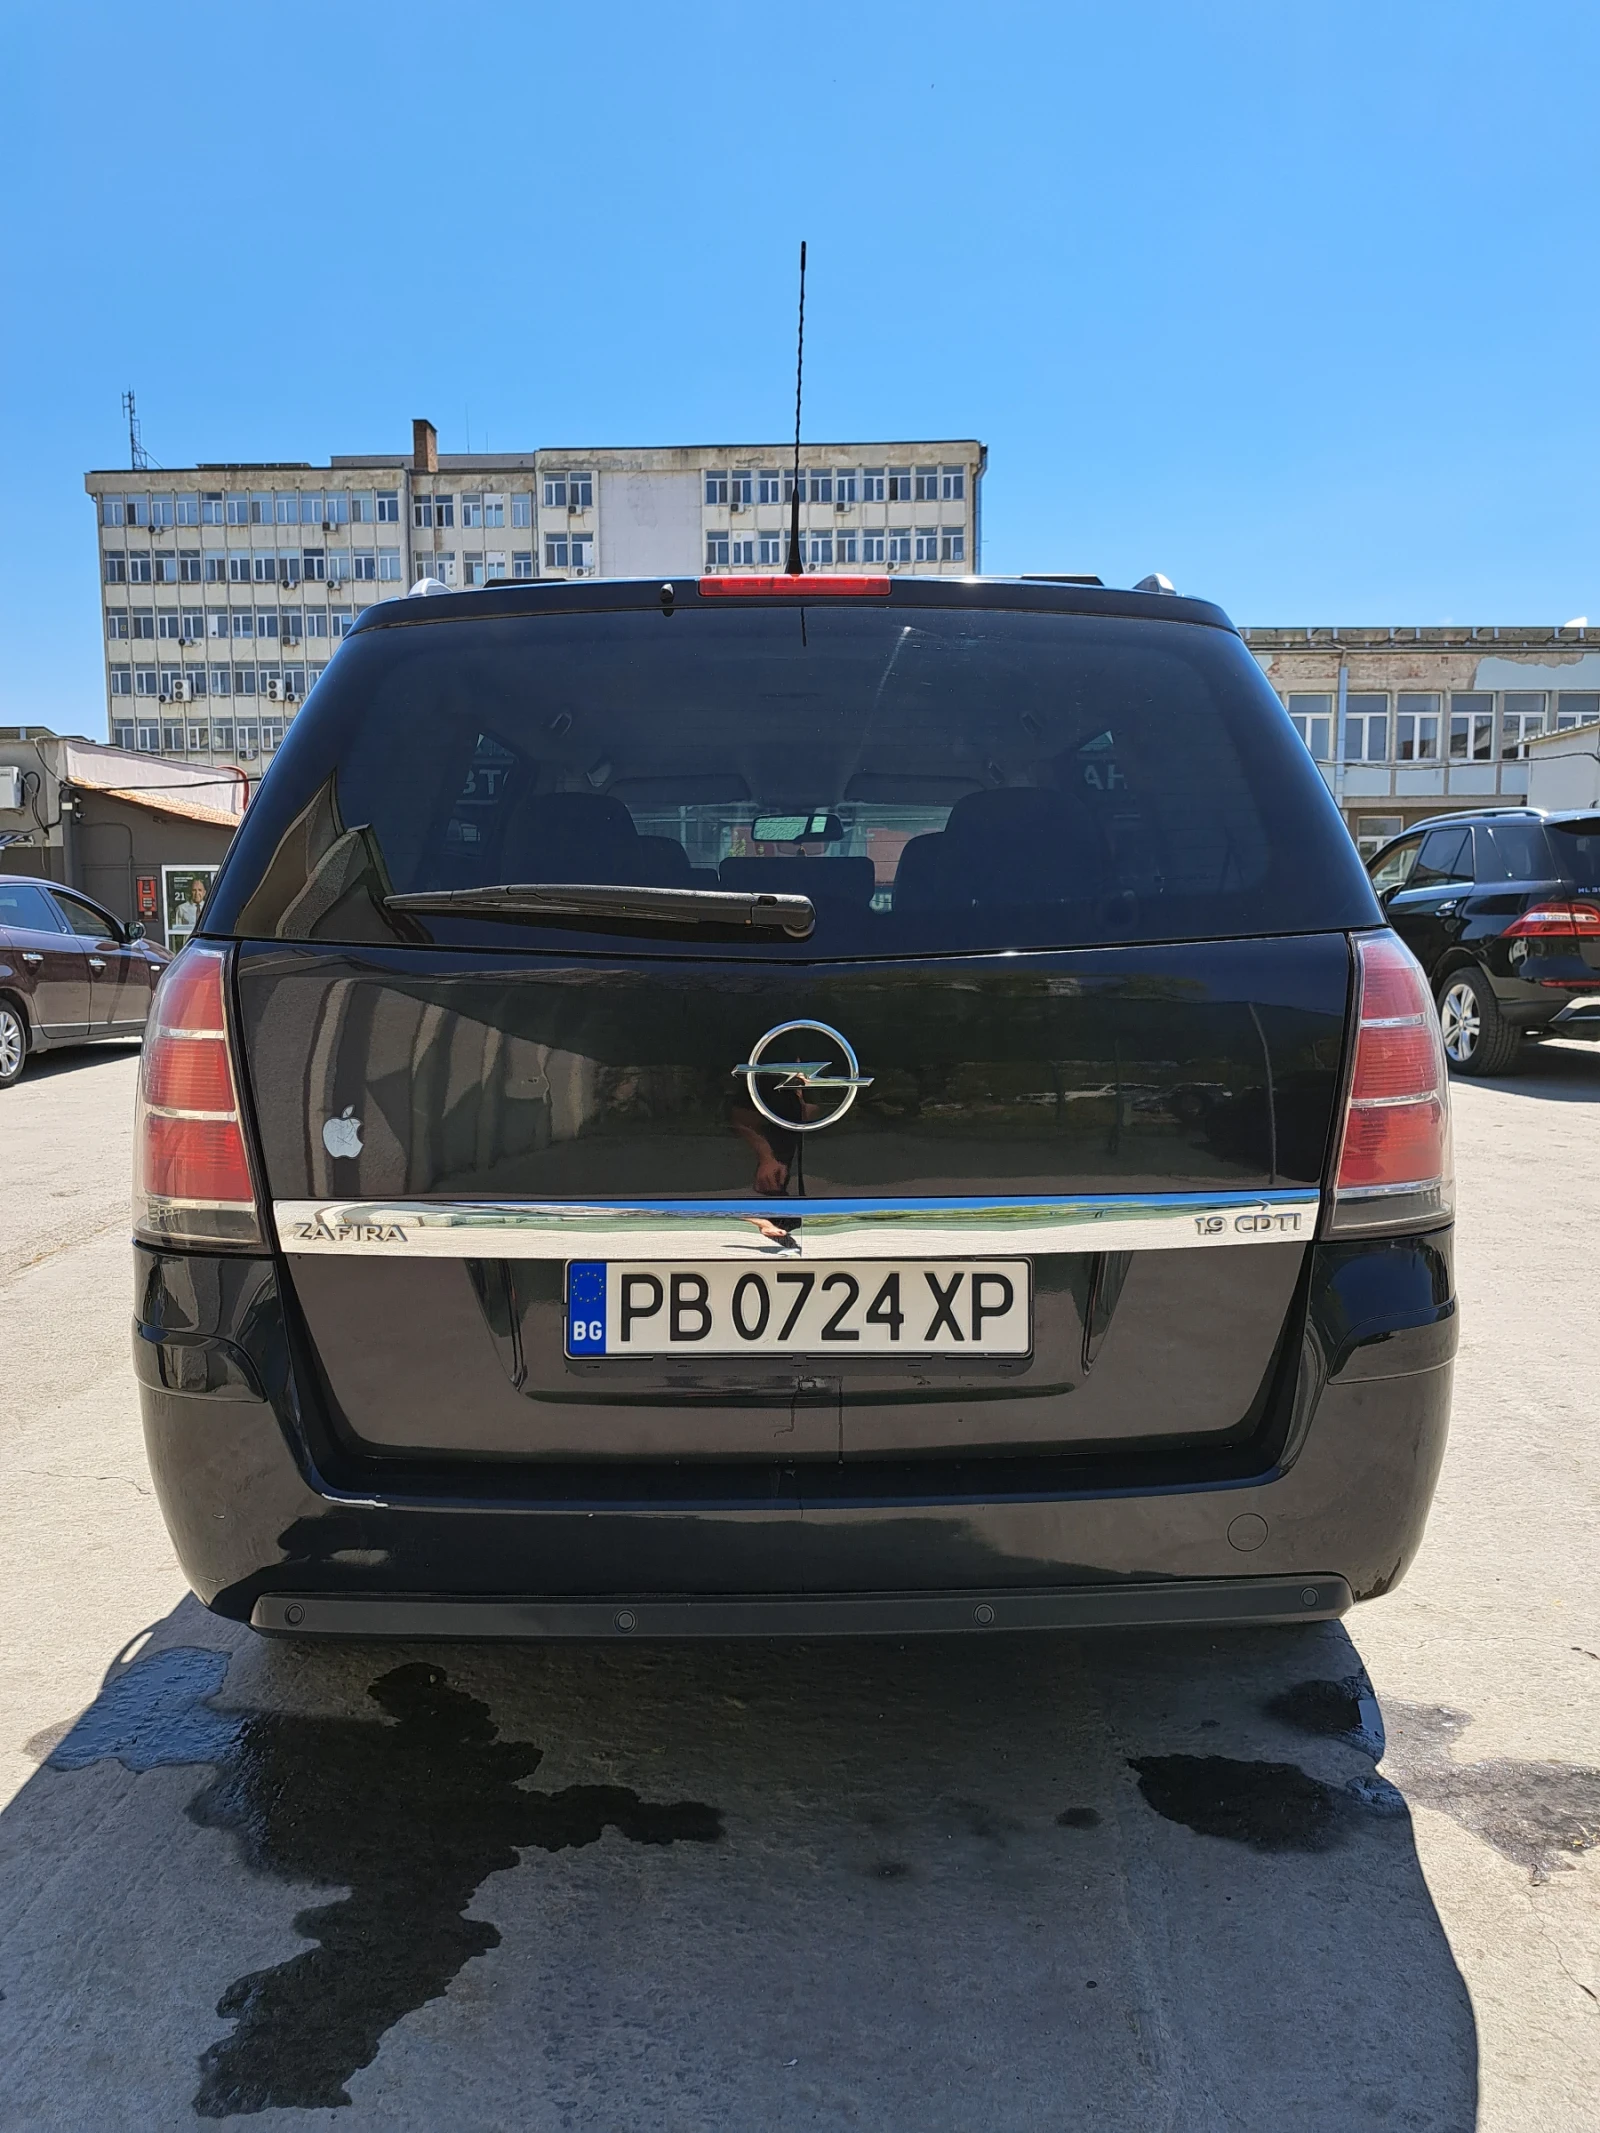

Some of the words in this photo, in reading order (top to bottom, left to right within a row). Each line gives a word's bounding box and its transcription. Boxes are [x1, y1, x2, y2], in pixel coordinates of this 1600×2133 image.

[174, 891, 186, 902] 21
[293, 1222, 409, 1242] ZAFIRA
[1234, 1212, 1302, 1234] CDTI
[621, 1273, 713, 1342] PB
[732, 1272, 905, 1342] 0724
[923, 1272, 1014, 1342] XP
[573, 1320, 603, 1341] BG
